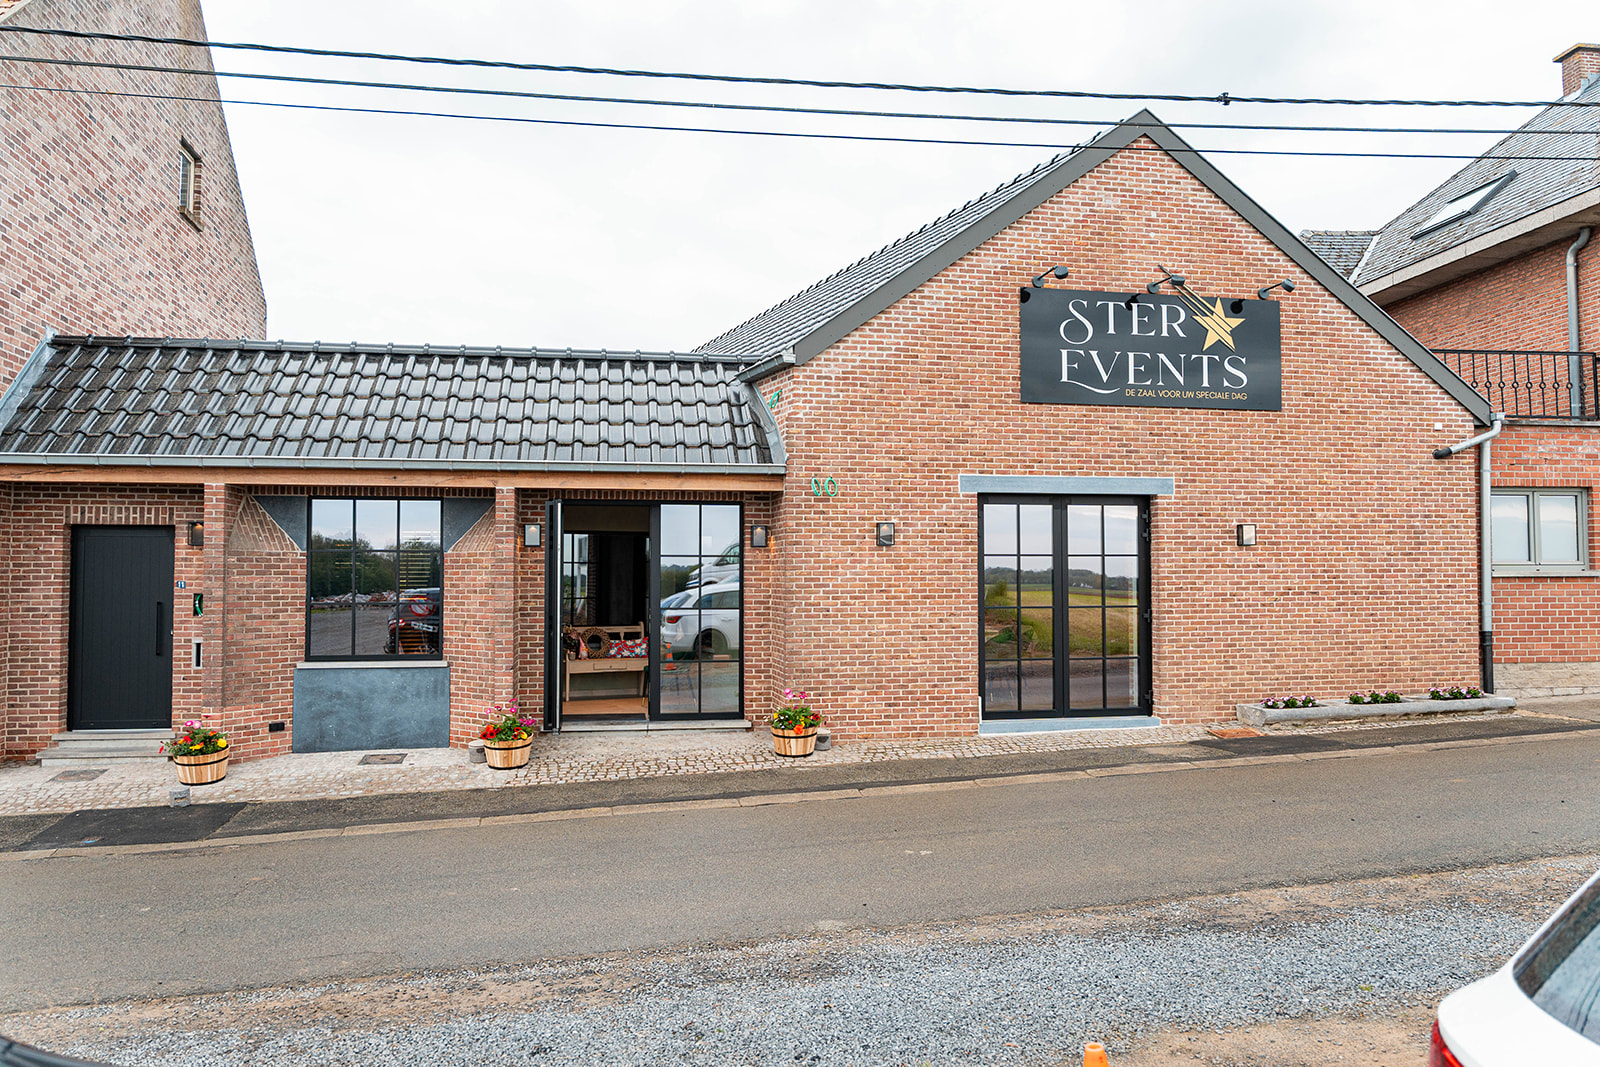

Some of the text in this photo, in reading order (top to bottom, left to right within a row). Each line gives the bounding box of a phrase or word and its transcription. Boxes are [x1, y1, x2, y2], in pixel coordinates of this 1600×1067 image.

[1059, 299, 1187, 344] STER
[1059, 349, 1248, 394] EVENTS
[1125, 388, 1136, 397] DE
[1138, 389, 1156, 397] ZAAL
[1159, 390, 1181, 398] VOOR
[1196, 391, 1229, 400] SPECIALE
[1232, 392, 1247, 400] DAG
